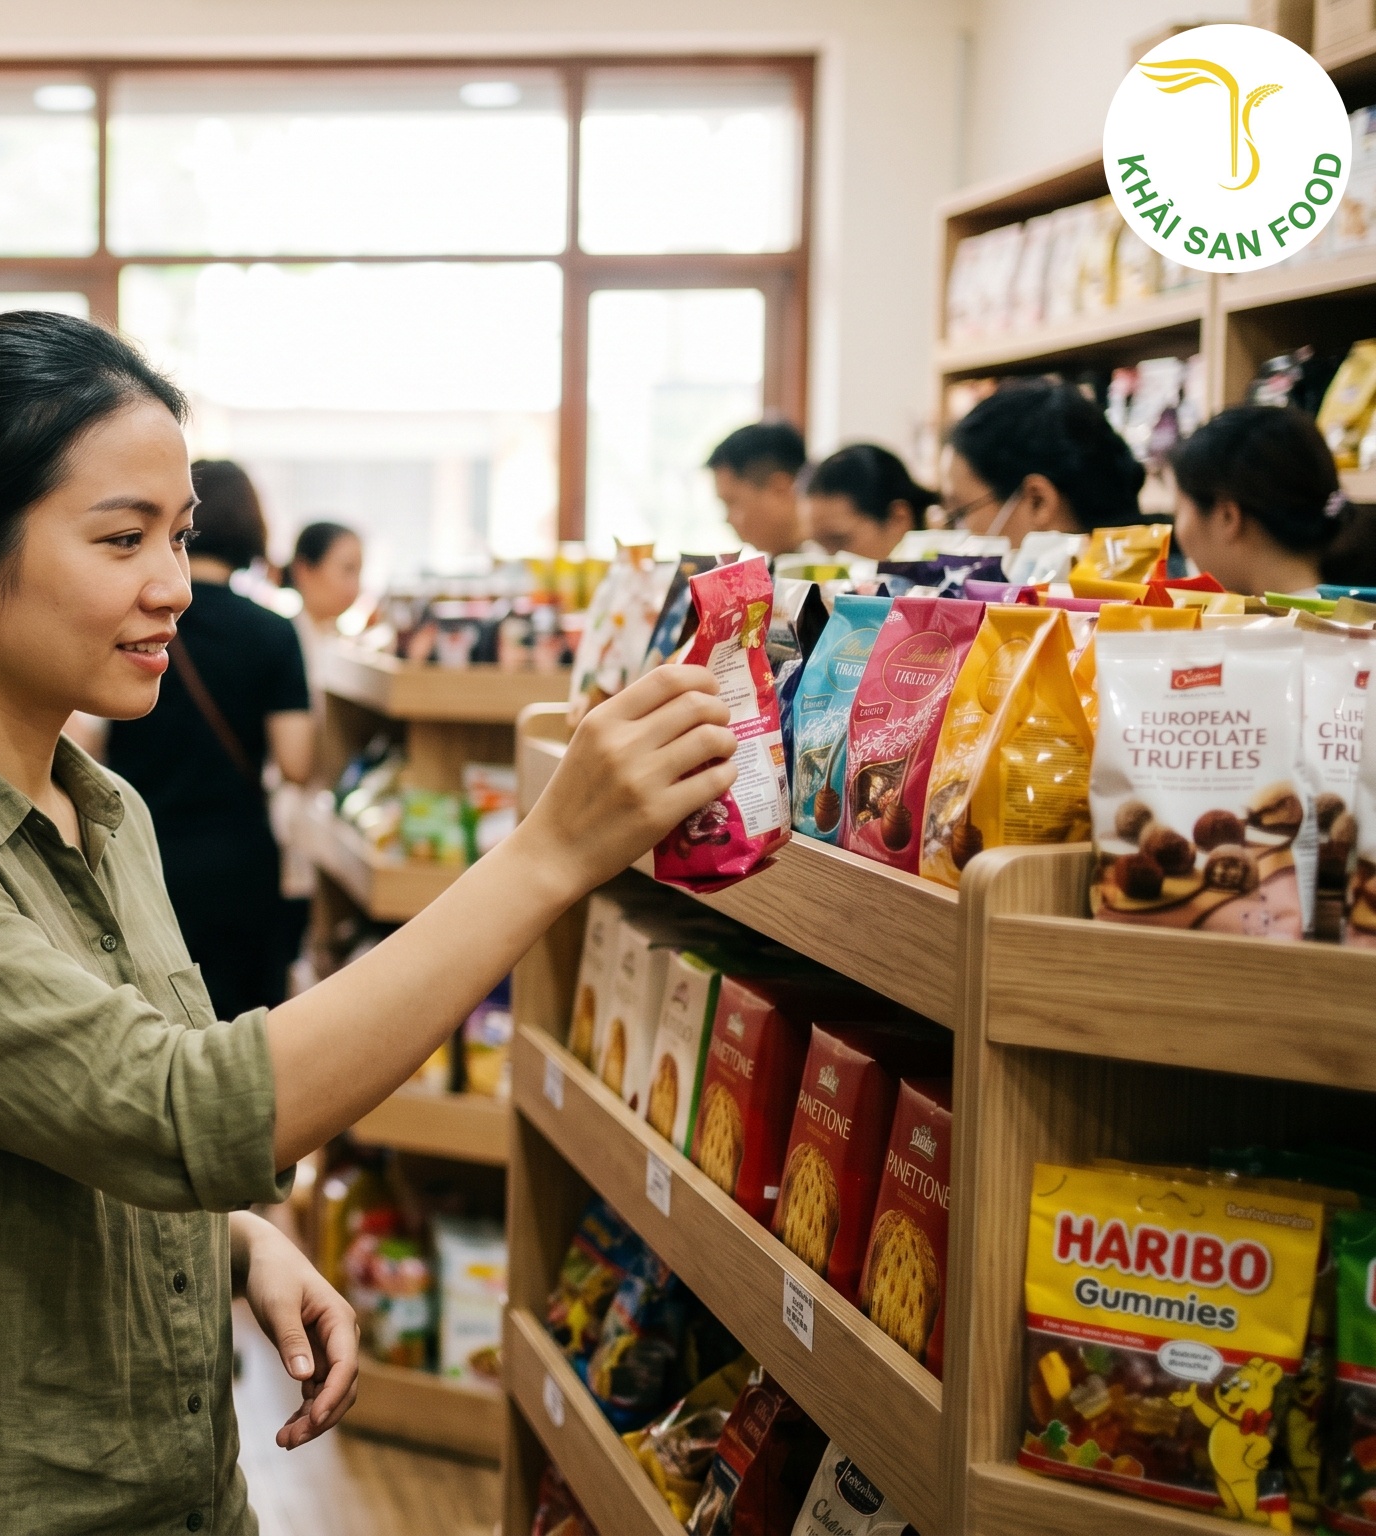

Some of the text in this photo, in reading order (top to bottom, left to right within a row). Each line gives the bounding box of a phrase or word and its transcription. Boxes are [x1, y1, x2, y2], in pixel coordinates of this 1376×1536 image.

[1123, 728, 1268, 747] CHOCOLATE
[1140, 709, 1251, 726] EUROPEAN
[1127, 748, 1261, 770] TRUFFLES
[797, 1089, 852, 1141] PANETTONE
[886, 1149, 951, 1210] PANETTONE
[1055, 1212, 1271, 1293] HARIBO
[1075, 1277, 1237, 1331] Gummies
